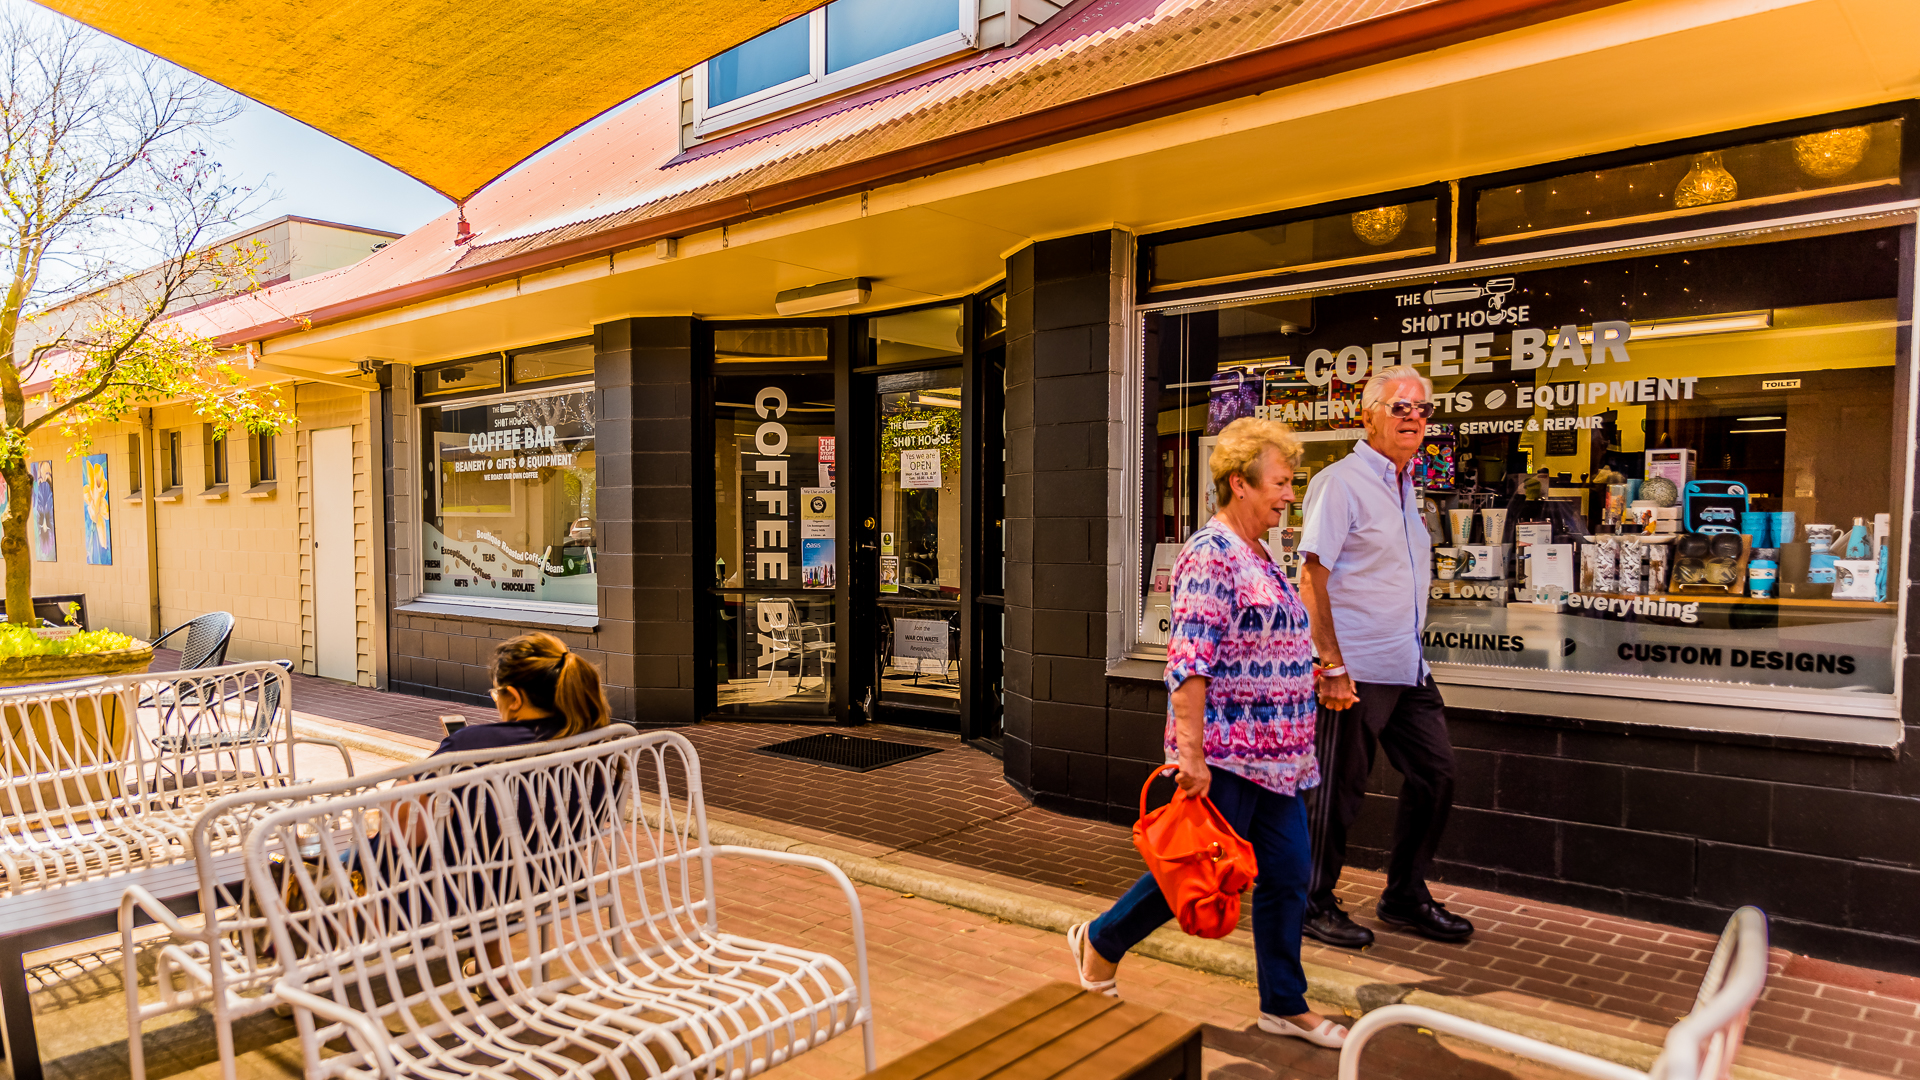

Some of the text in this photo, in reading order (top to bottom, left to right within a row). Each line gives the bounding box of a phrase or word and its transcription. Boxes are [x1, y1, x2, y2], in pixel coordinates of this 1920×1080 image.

[1395, 293, 1421, 307] THE
[1401, 313, 1452, 334] SHOT
[1304, 320, 1631, 387] COFFEE BAR
[1254, 376, 1699, 422] BEANERY FTS EQUIPMENT
[891, 422, 902, 430] THE
[1459, 420, 1524, 435] SERVICE
[1526, 418, 1539, 432] &
[1543, 416, 1604, 431] REPAIR
[468, 425, 556, 454] COFFEE BAR
[455, 454, 573, 473] BEANERY GIFTS EQUIPMENT
[910, 461, 932, 470] OPEN
[491, 473, 504, 481] ROAST
[513, 472, 523, 480] OWN
[523, 471, 539, 479] COFFEE
[755, 386, 789, 581] COFFEE
[441, 546, 471, 569] Exceptional
[476, 529, 501, 548] Boutique
[501, 541, 524, 562] Roasted
[545, 563, 564, 574] Beans
[482, 553, 496, 562] TEAS
[424, 560, 441, 569] FRESH
[511, 569, 523, 578] HOT
[424, 572, 441, 581] BEANS
[454, 578, 469, 588] GIFTS
[501, 582, 535, 592] CHOCOLATE
[1449, 581, 1508, 599] Lover
[1567, 593, 1700, 623] everything
[1420, 631, 1856, 675] MACHINES CUSTOM DESIGNS
